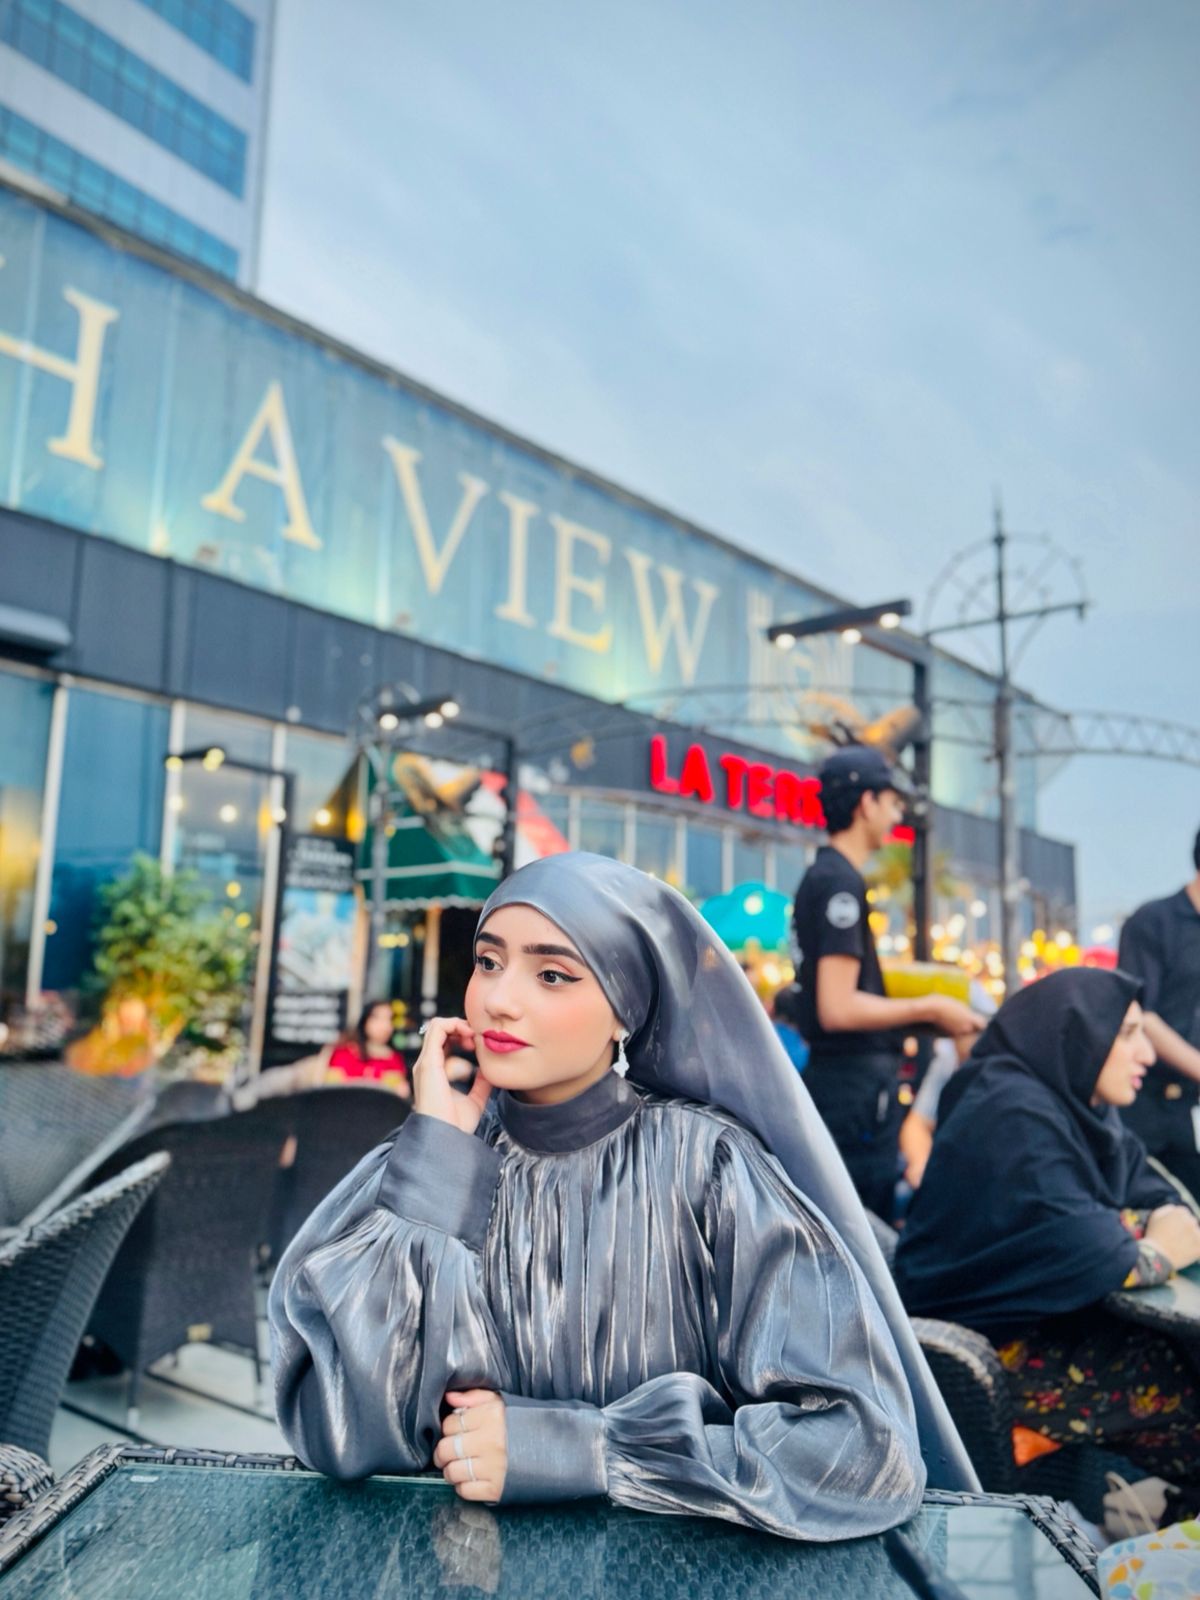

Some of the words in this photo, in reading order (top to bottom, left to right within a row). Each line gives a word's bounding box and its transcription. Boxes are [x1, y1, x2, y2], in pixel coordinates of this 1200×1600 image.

[201, 380, 322, 550] A
[381, 435, 721, 685] VIEW
[650, 733, 715, 804] LA
[720, 753, 828, 829] TERR
